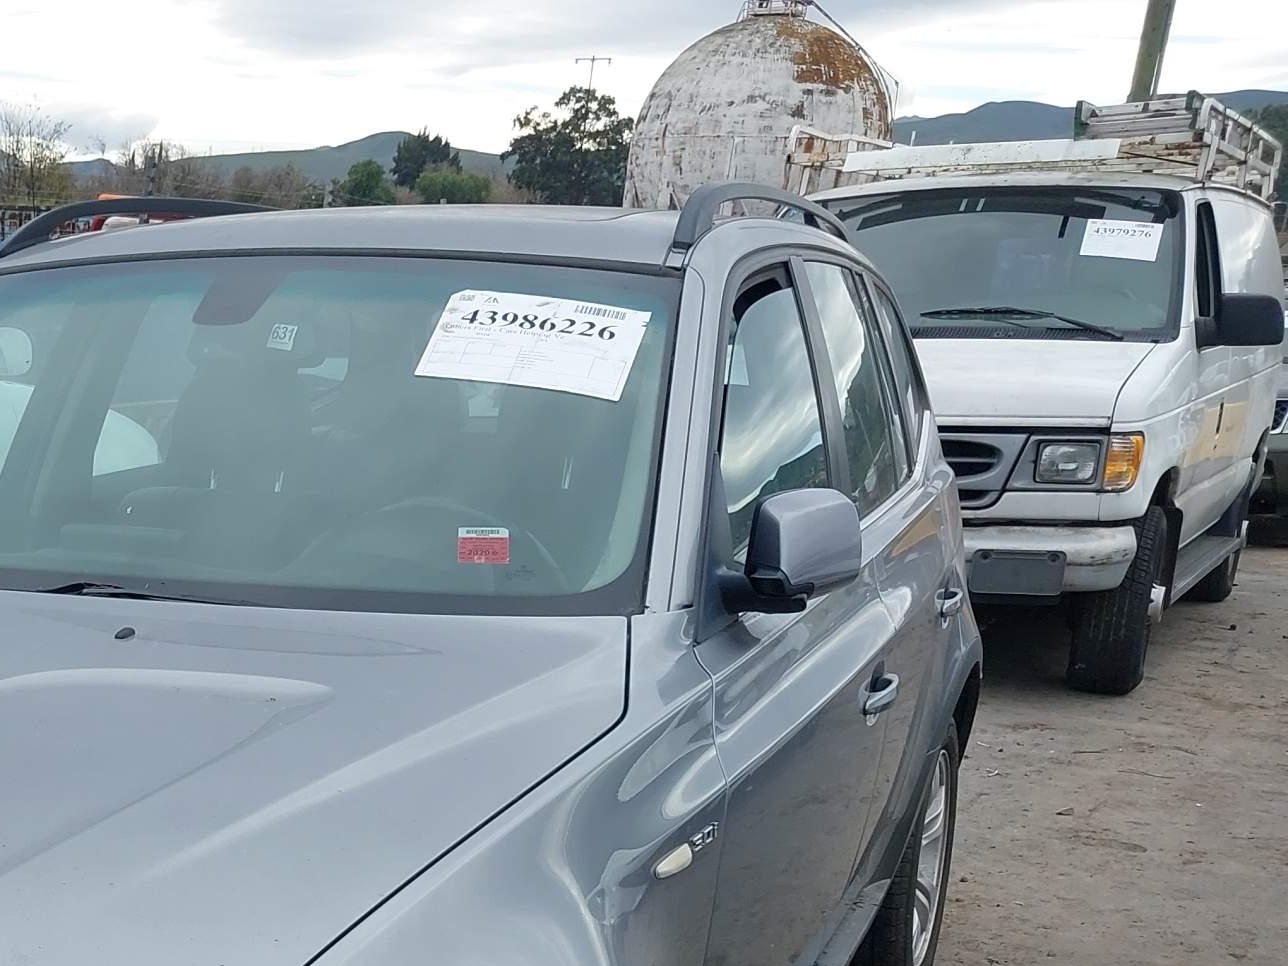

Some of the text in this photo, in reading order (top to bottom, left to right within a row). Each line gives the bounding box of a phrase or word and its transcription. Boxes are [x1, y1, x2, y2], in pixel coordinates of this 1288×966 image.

[1093, 227, 1152, 238] 43979276
[461, 309, 620, 341] 43986226
[271, 326, 296, 342] 631
